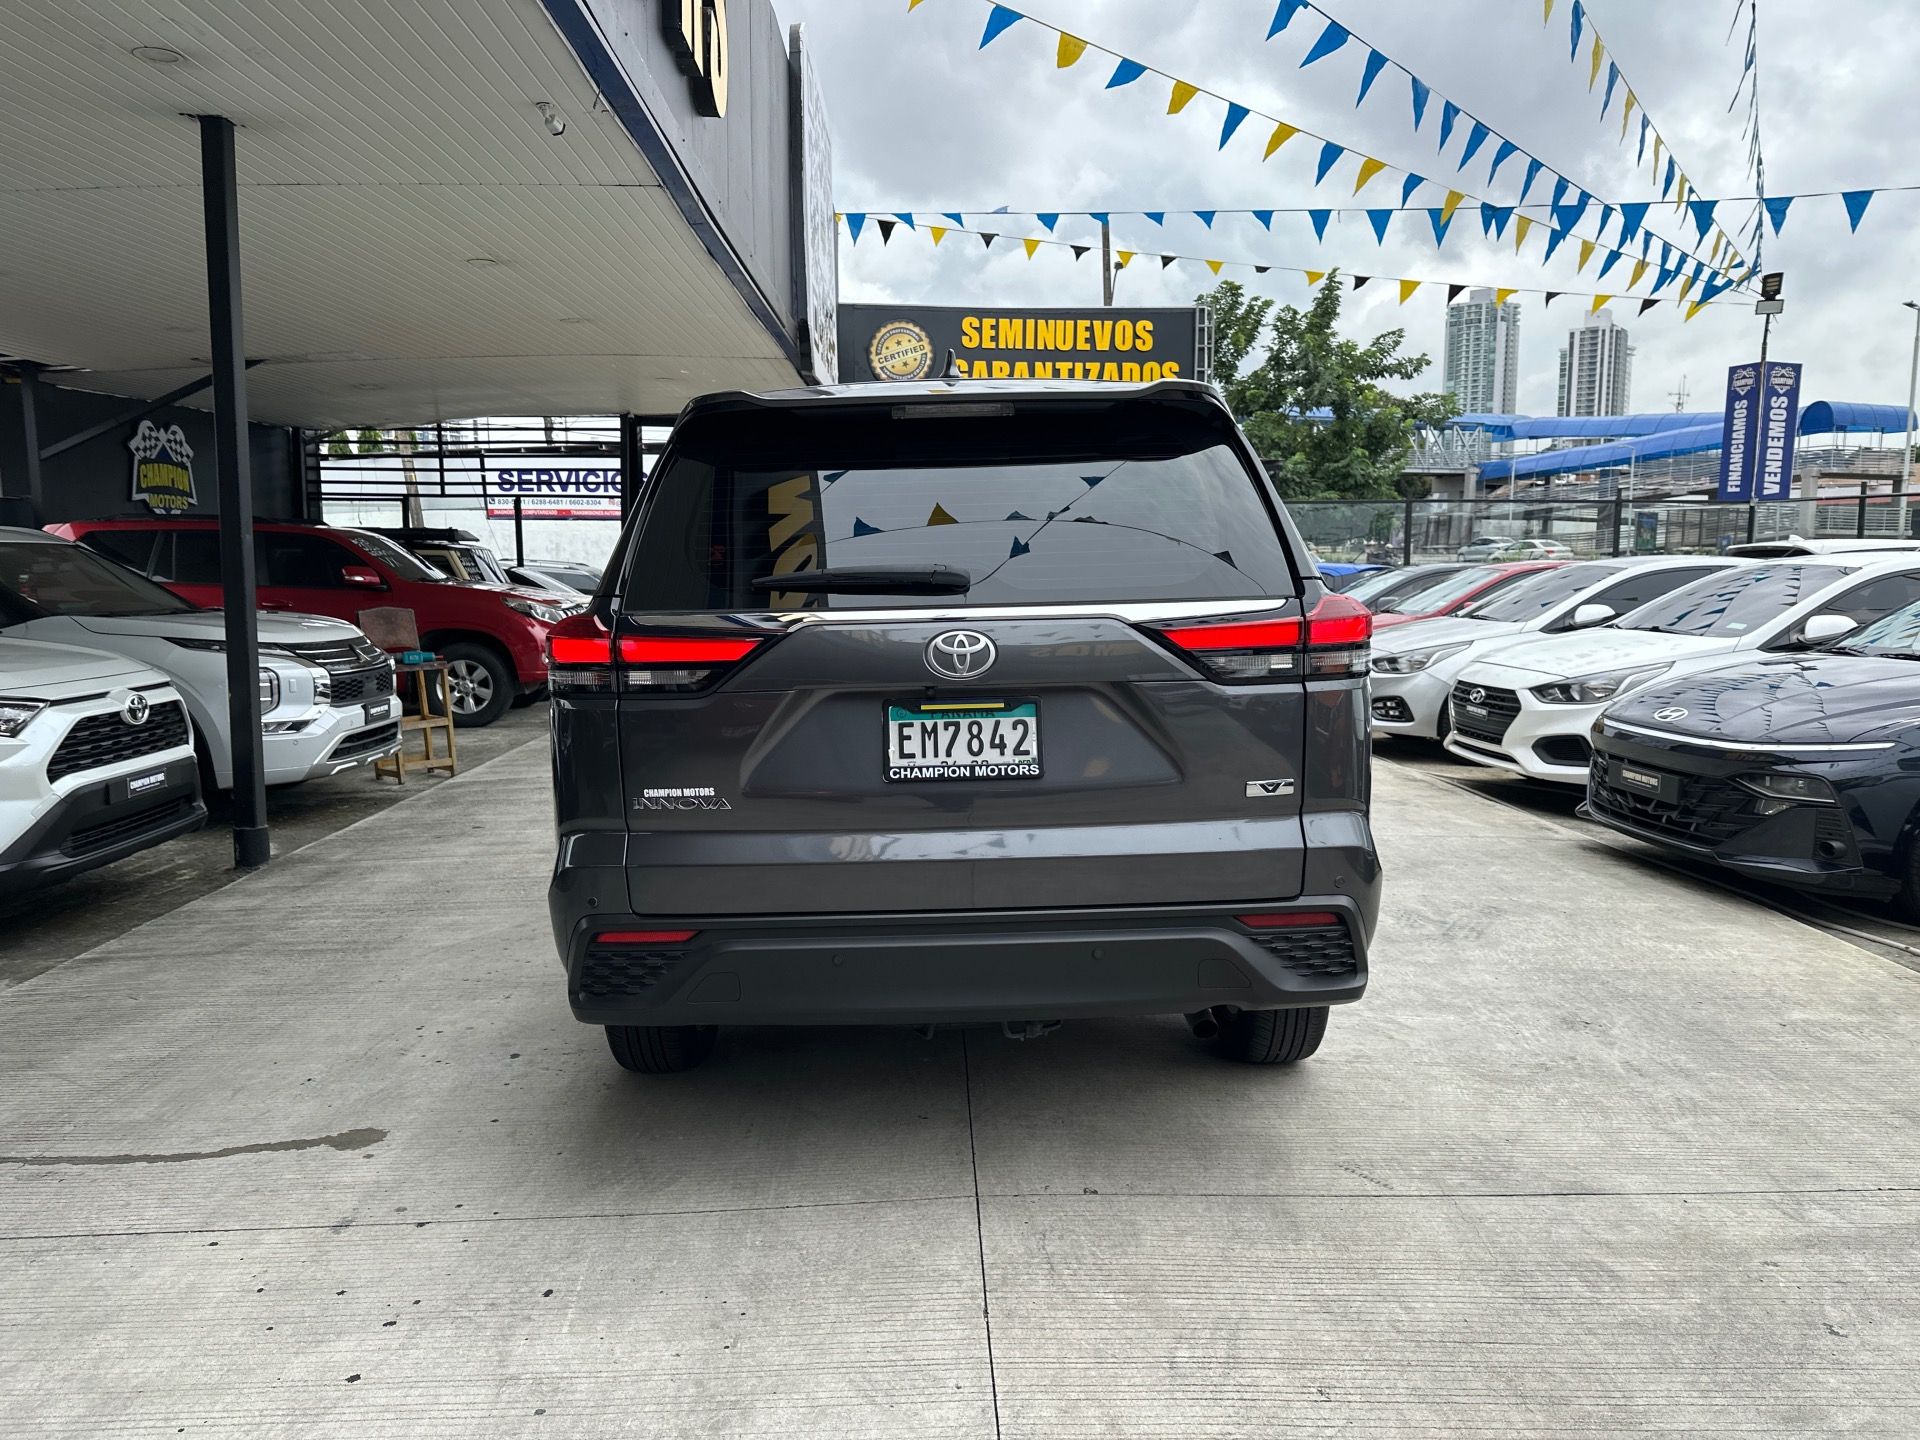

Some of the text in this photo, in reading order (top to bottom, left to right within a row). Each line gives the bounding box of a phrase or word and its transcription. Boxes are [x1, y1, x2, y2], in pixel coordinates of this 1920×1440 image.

[961, 316, 1154, 352] SEMINUEVOS
[878, 344, 926, 365] CERTIFIED
[1727, 399, 1748, 493] FINANCIAMOS
[1763, 396, 1788, 495] VENDEMOS
[140, 463, 190, 493] CHAMPION
[148, 494, 189, 510] MOTORS
[898, 719, 1031, 760] EM7842
[889, 765, 1040, 779] CHAMPION MOTORS
[632, 797, 732, 810] INNOVA
[643, 787, 715, 798] CHAMPION MOTORS
